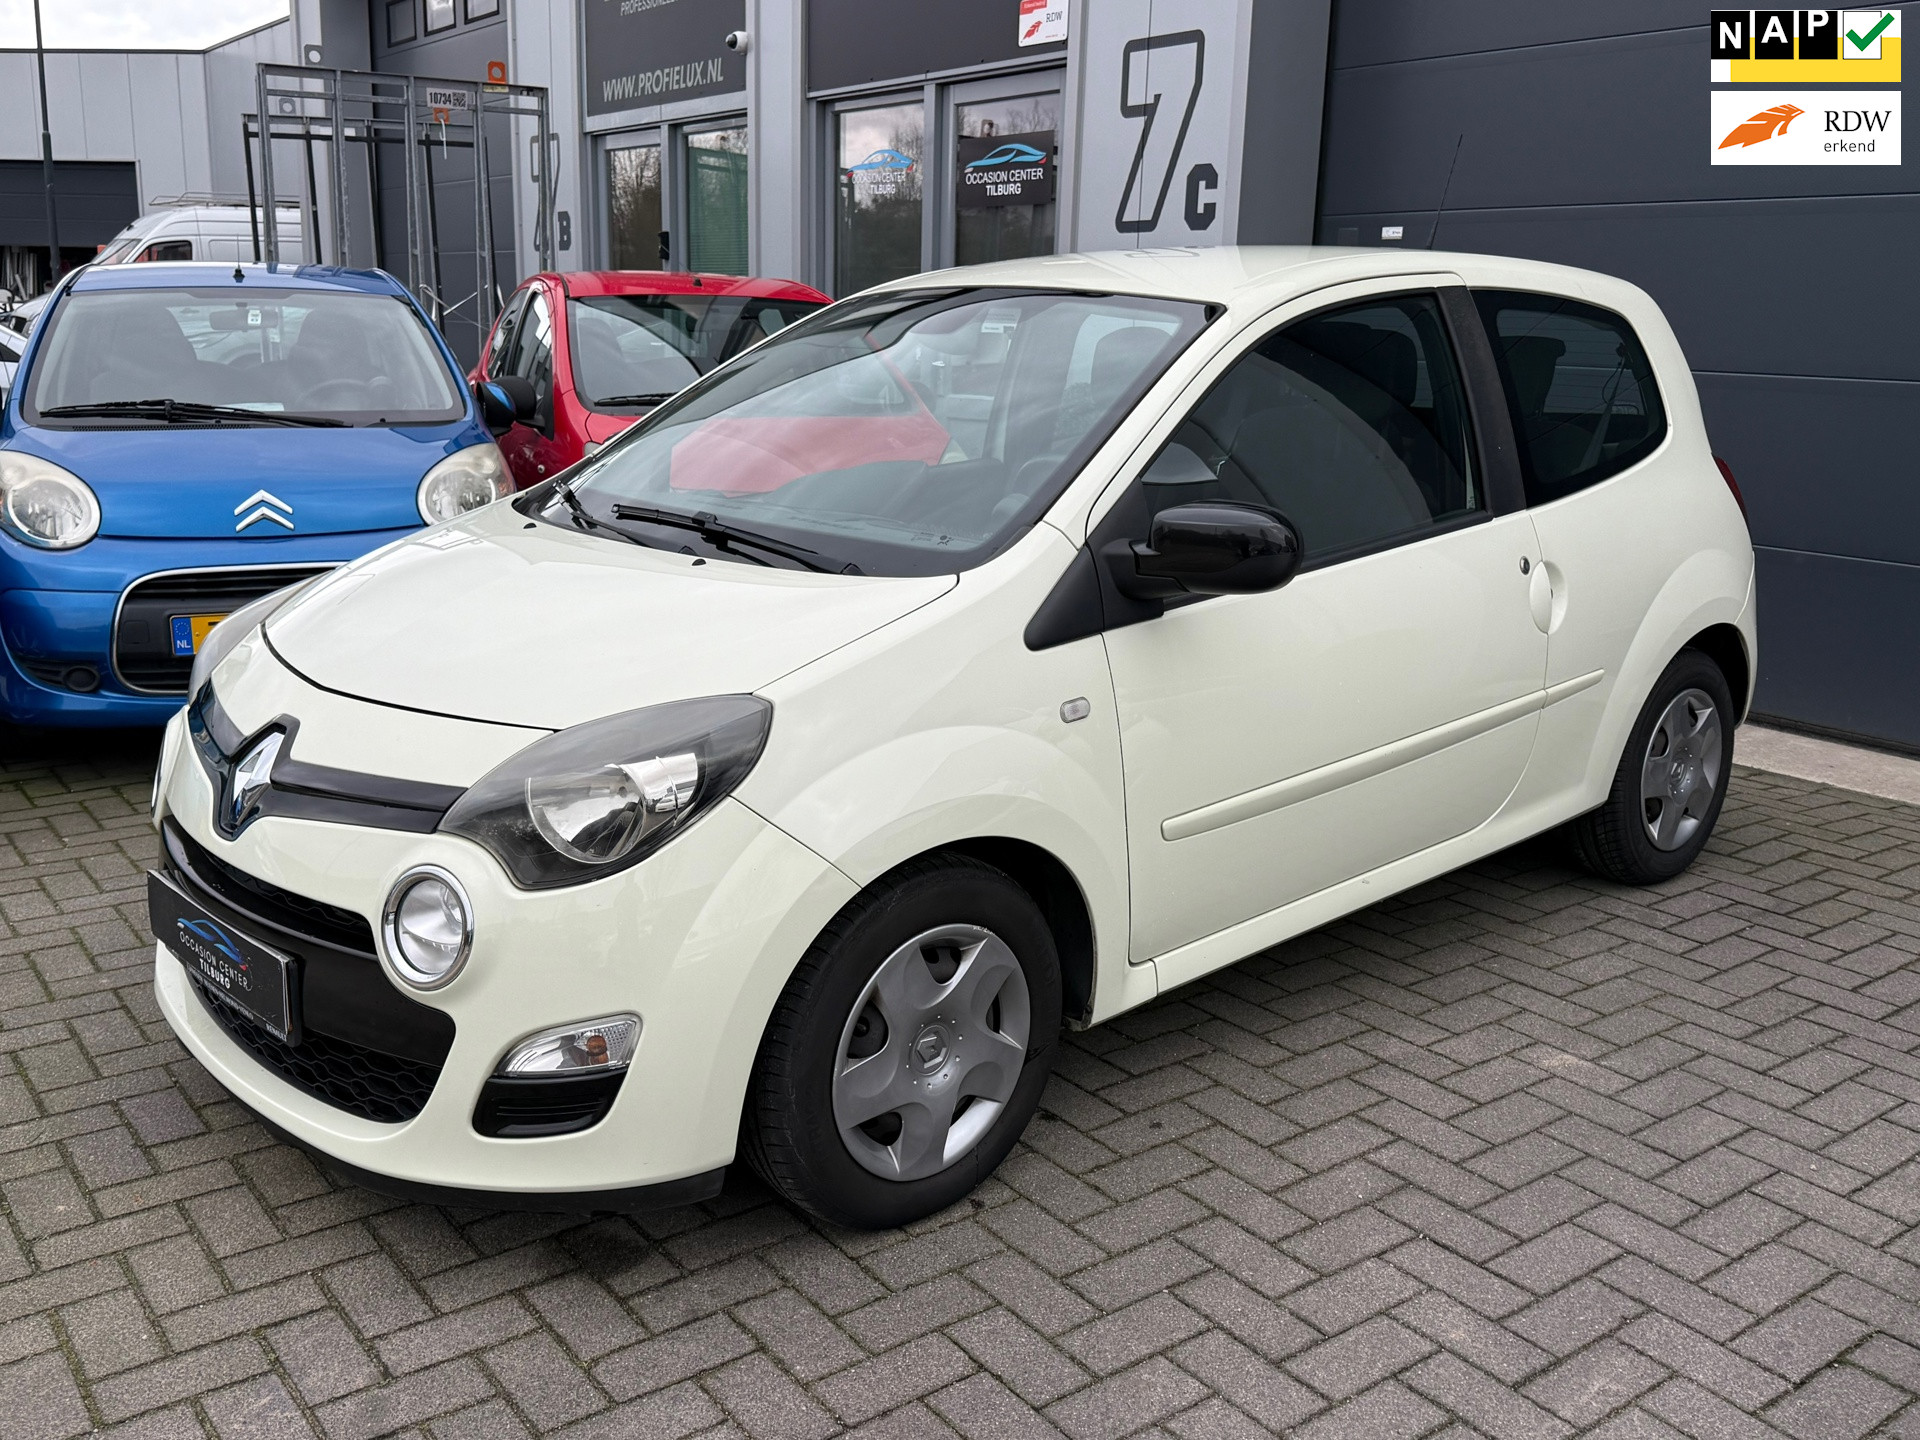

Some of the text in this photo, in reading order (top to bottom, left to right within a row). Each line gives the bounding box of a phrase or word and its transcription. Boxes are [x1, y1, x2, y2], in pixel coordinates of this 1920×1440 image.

[1046, 11, 1063, 23] RDW
[603, 57, 724, 102] WWW.PROFIELUX.NL
[852, 170, 906, 184] OCCASION CENTER
[966, 168, 1044, 185] OCCASION CENTER
[870, 184, 896, 195] TILBURG
[986, 182, 1021, 196] TILBURG
[176, 640, 191, 648] NL
[179, 931, 217, 966] OCCASION
[219, 960, 248, 989] CENTER
[199, 958, 231, 989] TILBURG
